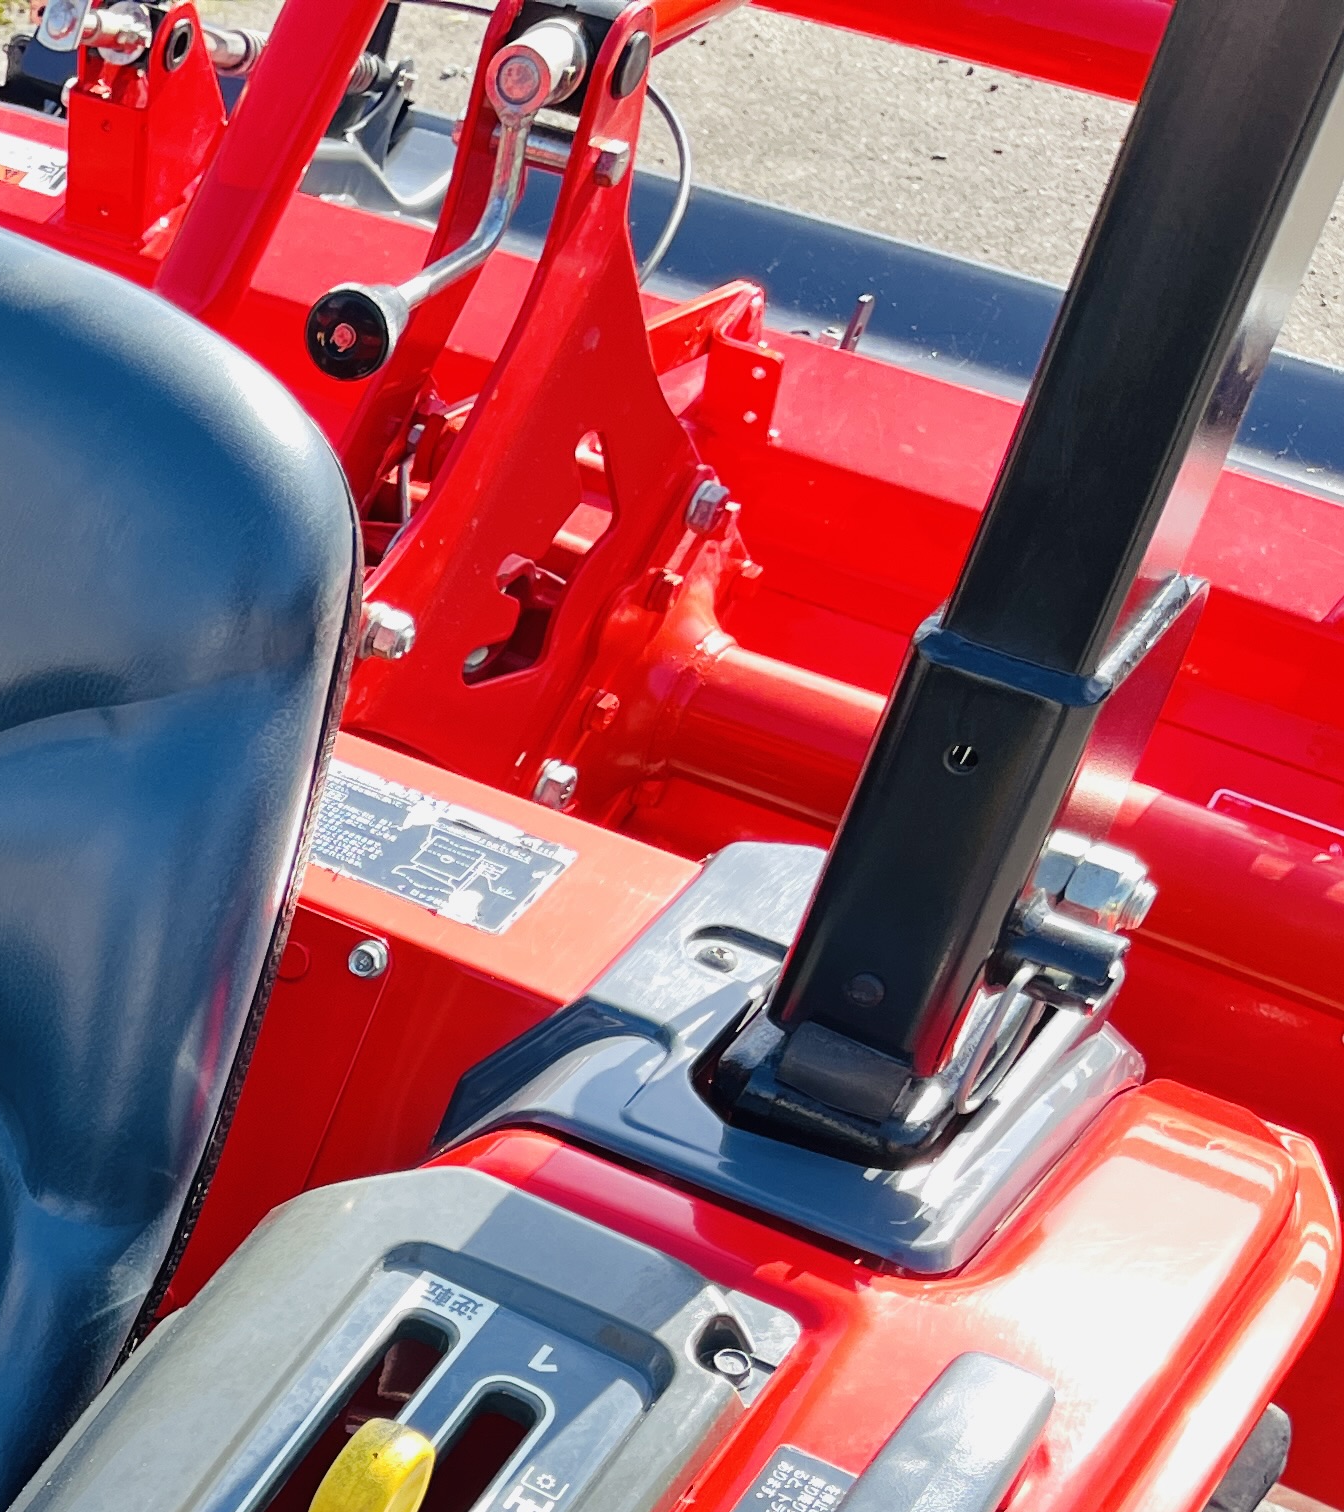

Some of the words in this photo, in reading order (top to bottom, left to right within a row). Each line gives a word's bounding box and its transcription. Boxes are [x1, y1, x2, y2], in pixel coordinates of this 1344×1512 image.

[421, 1280, 484, 1321] 逆転
[528, 1344, 558, 1373] 1
[754, 1459, 793, 1501] あります。
